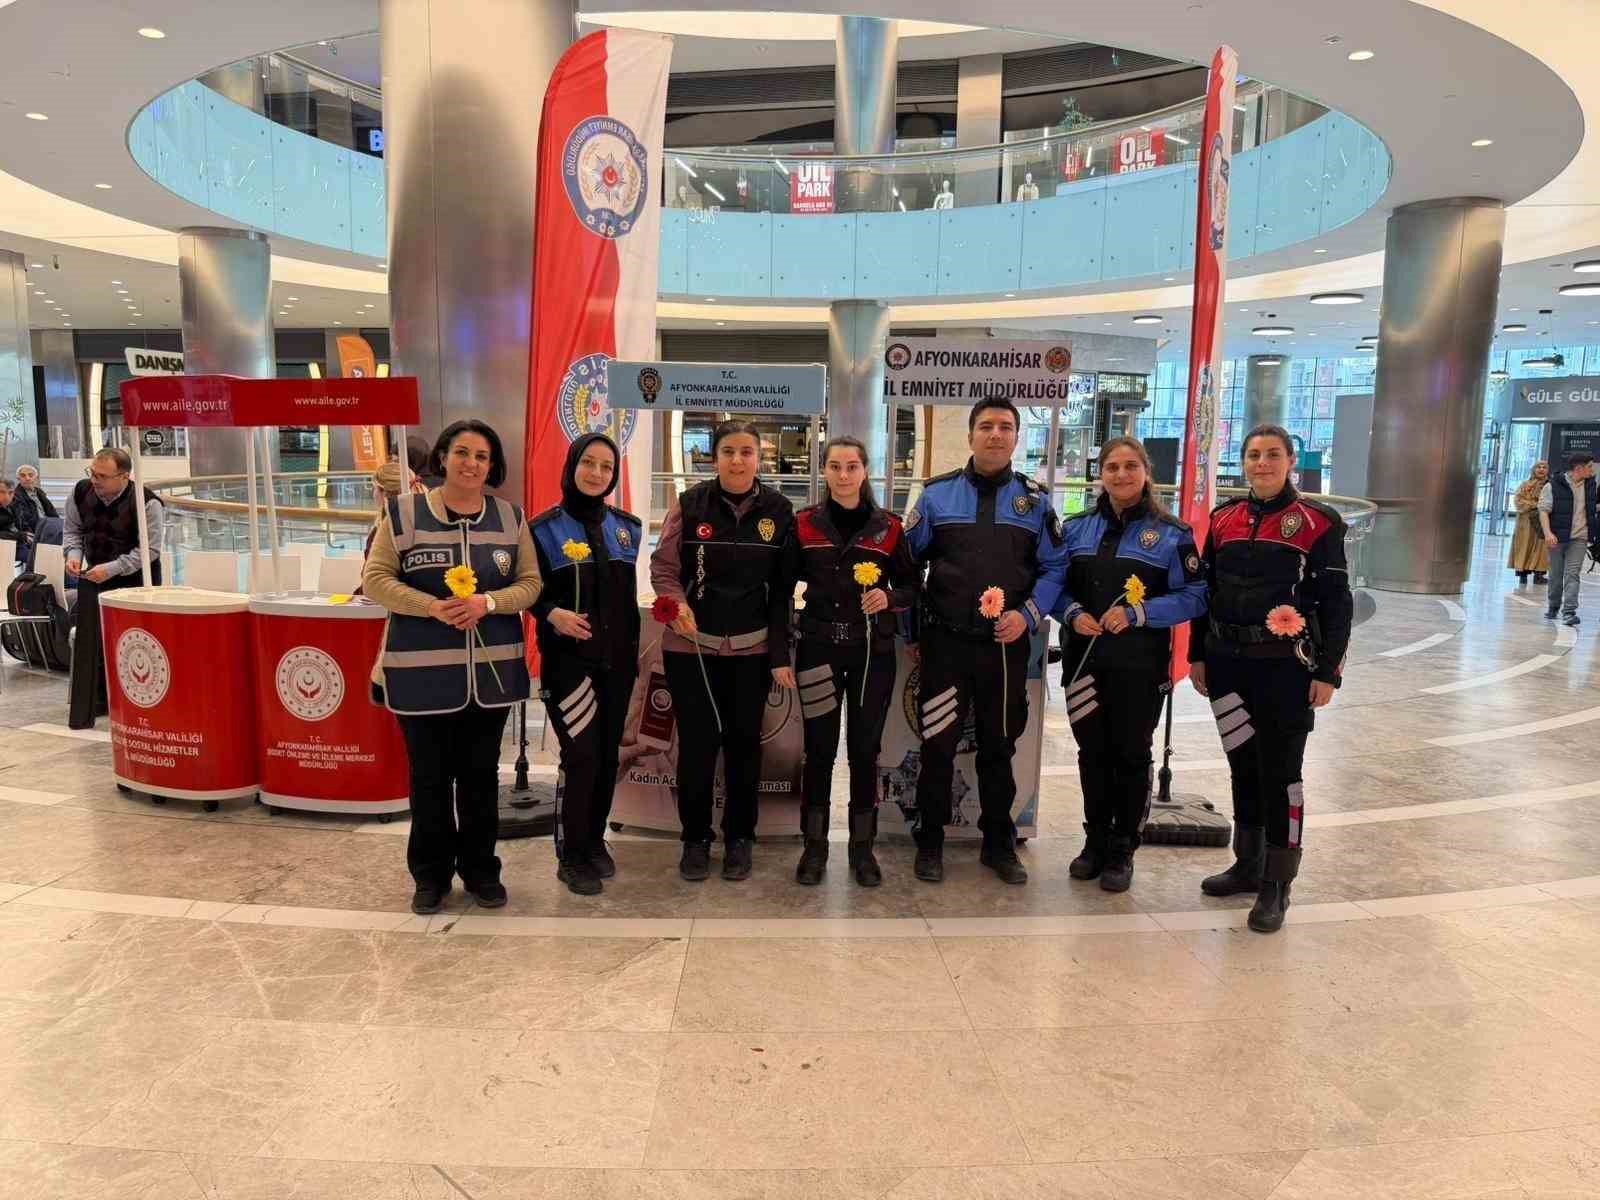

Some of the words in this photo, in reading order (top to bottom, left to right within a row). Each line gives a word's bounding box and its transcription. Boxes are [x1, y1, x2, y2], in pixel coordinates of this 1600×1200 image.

[797, 182, 831, 198] PARK
[914, 347, 1042, 368] AFYONKARAHİSAR
[721, 370, 737, 380] T.C.
[670, 383, 752, 394] AFYONKARAHİSAR
[884, 376, 897, 396] İL
[902, 377, 965, 397] EMNİYET
[969, 377, 1068, 399] MÜDÜRLÜĞÜ
[294, 396, 360, 407] www.aile.gov.tr
[685, 397, 722, 407] EMNİYET
[725, 397, 785, 408] MÜDÜRLÜĞÜ
[1527, 390, 1563, 403] GÜLE
[142, 398, 228, 414] www.aile.gov.tr
[153, 743, 200, 756] HİZMETLER
[630, 770, 660, 784] Kadın
